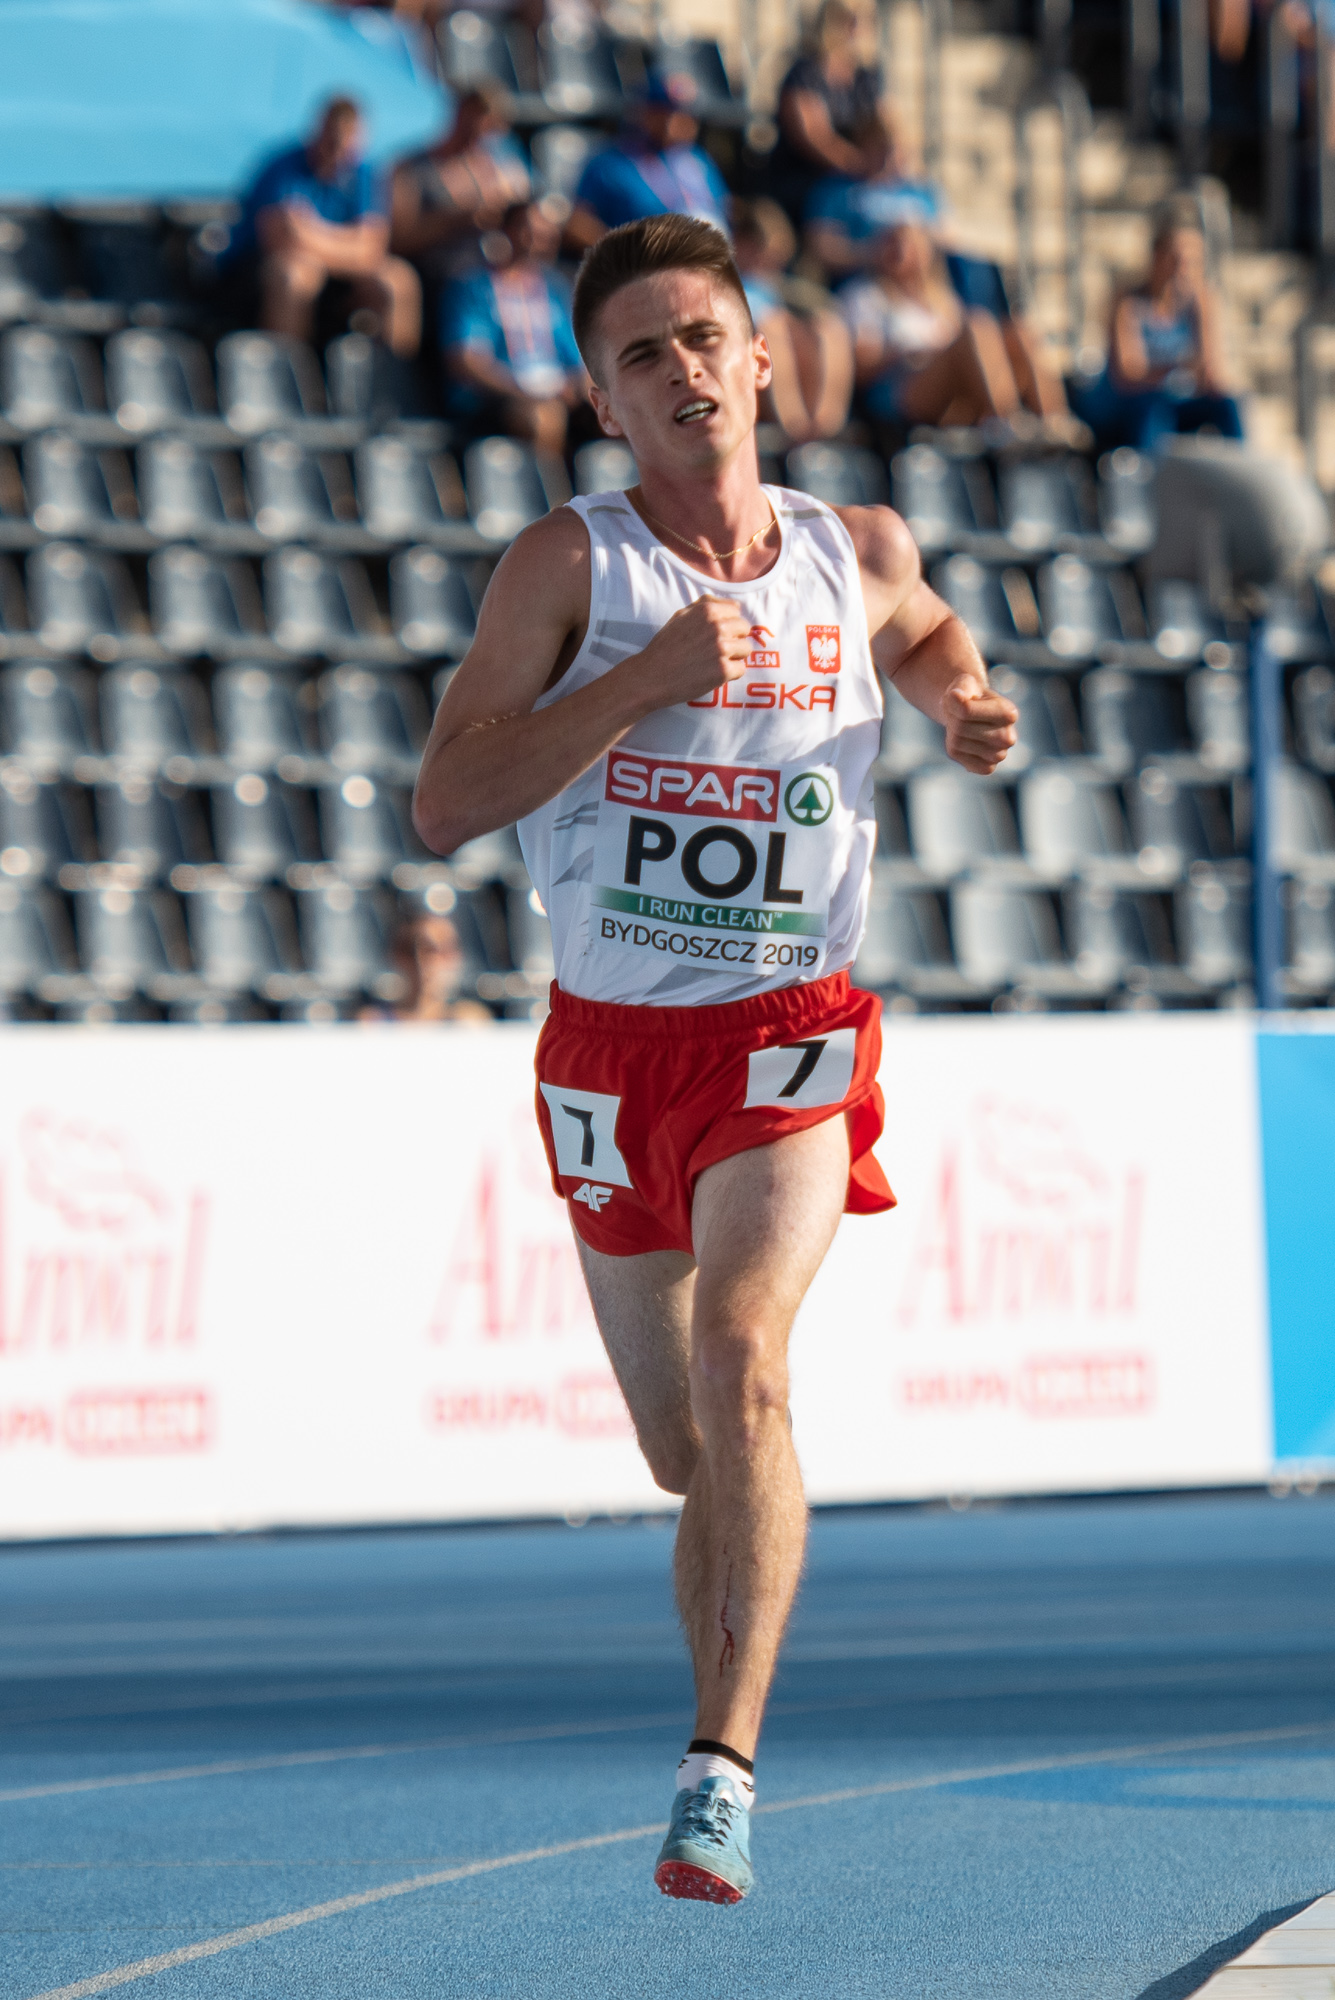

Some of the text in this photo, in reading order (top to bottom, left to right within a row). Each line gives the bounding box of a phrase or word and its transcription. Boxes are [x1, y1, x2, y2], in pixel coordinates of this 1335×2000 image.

[807, 626, 838, 634] POLSKA
[745, 652, 778, 666] LEN
[610, 759, 775, 814] SPAR
[624, 814, 804, 905] POL
[638, 896, 644, 913] I
[650, 899, 695, 922] RUN
[600, 917, 819, 967] BYDGOSZCZ 2019
[777, 1039, 829, 1098] 7
[560, 1103, 595, 1167] 7
